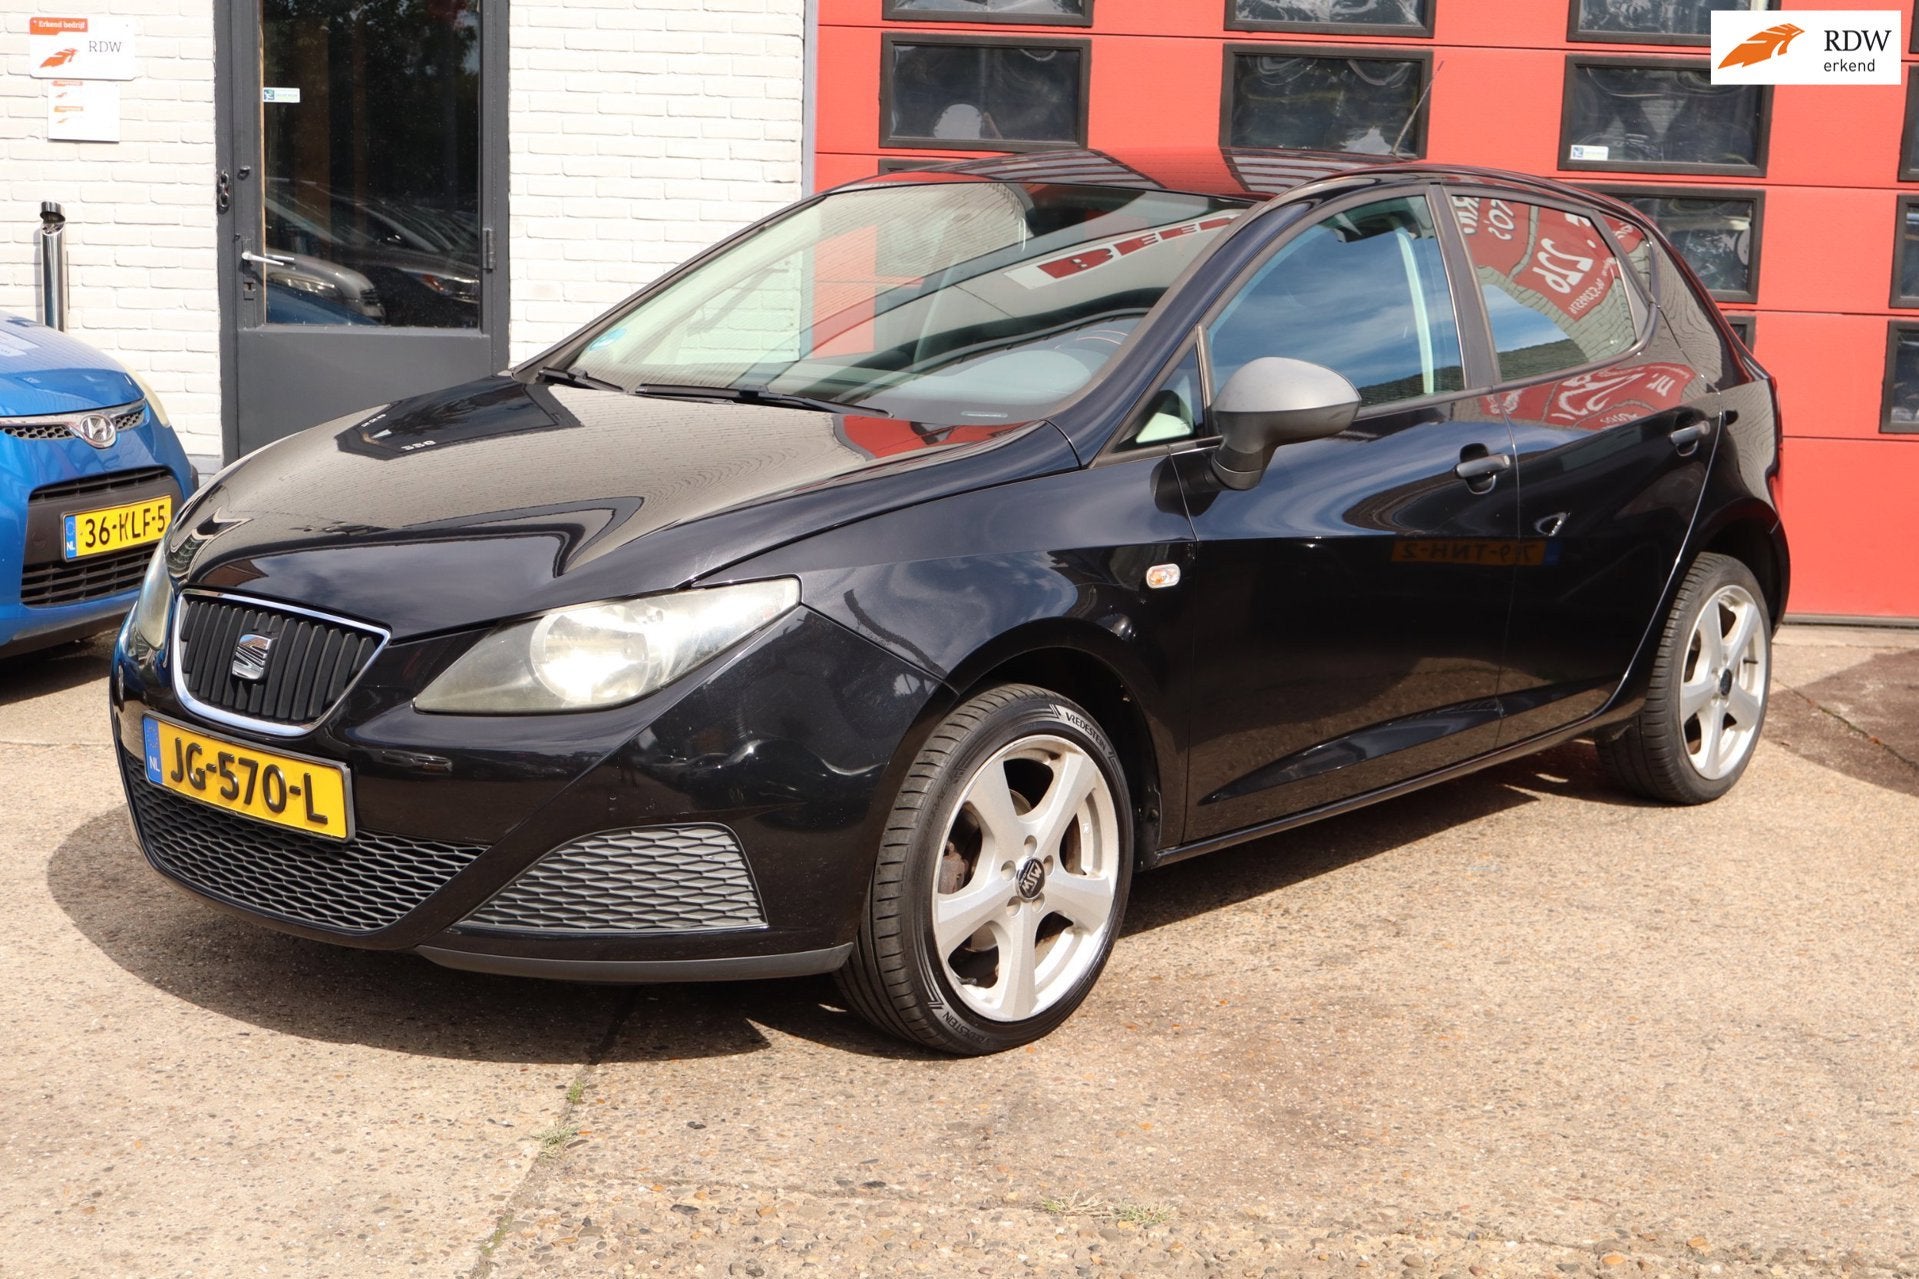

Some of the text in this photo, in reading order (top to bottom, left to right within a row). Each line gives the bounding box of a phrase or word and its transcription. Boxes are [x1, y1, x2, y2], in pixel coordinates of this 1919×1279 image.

[88, 40, 122, 53] RDW
[84, 504, 166, 549] 36-KLF-5
[66, 541, 76, 551] NL
[1065, 711, 1107, 751] VREDESTEIN
[148, 755, 160, 773] NL
[171, 737, 328, 825] JG-570-L
